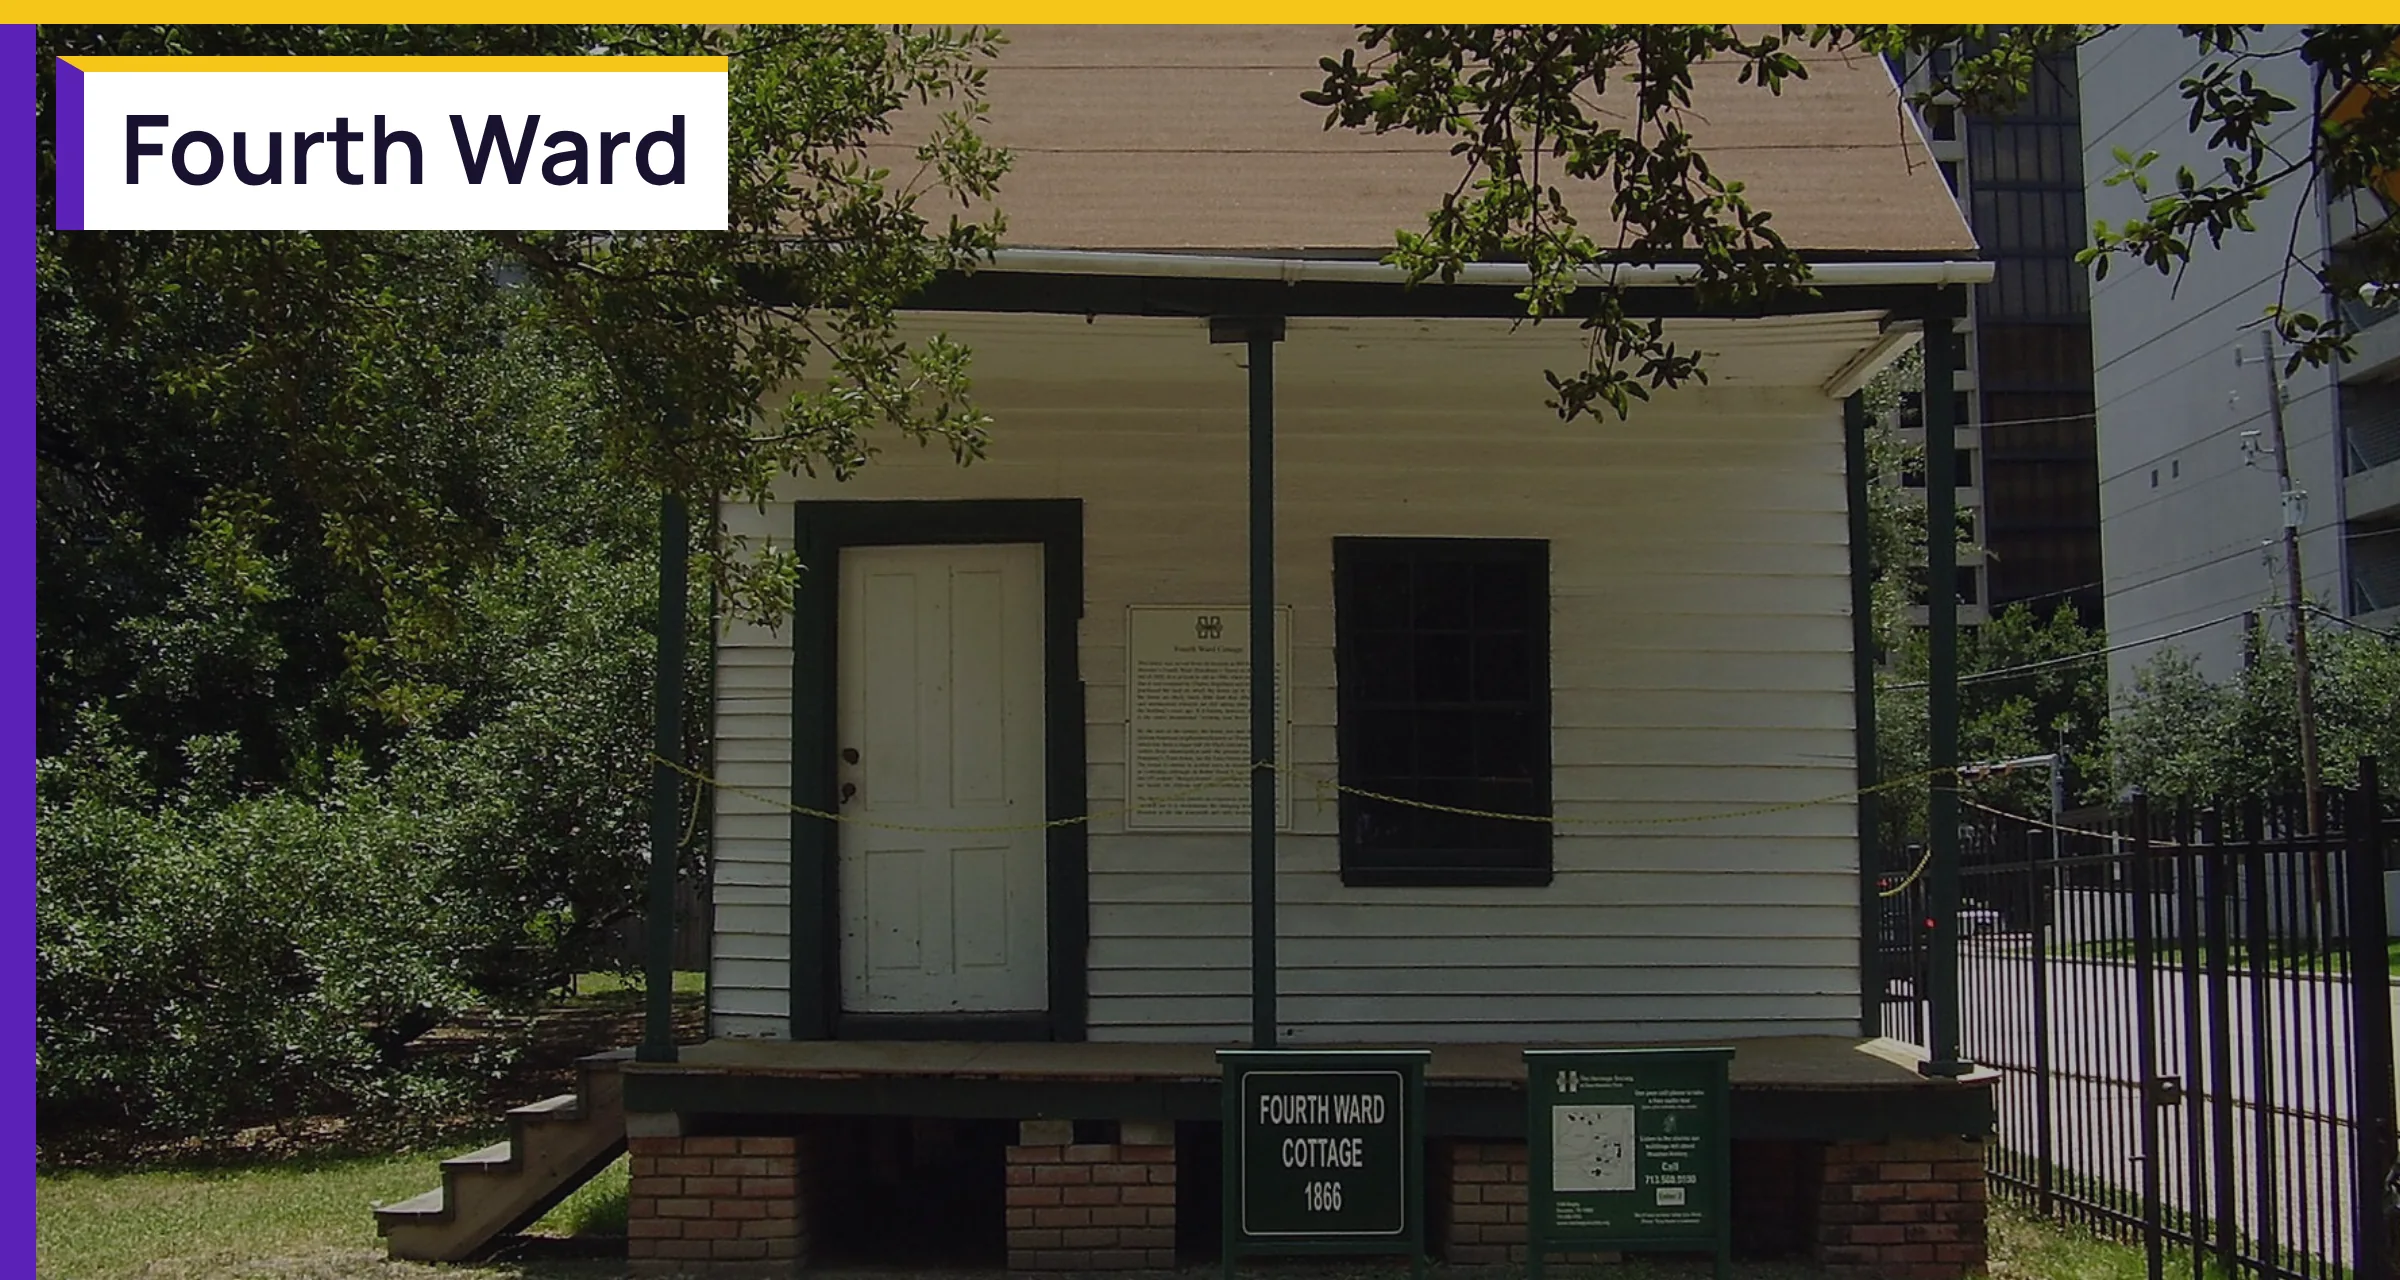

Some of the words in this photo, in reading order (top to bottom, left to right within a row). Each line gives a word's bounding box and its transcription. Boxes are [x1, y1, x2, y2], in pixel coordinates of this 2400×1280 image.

[1260, 1094, 1329, 1125] FOURTH
[1334, 1094, 1385, 1125] WARD
[1282, 1138, 1363, 1168] COTTAGE
[1661, 1161, 1679, 1172] Call
[1304, 1181, 1342, 1211] 1866
